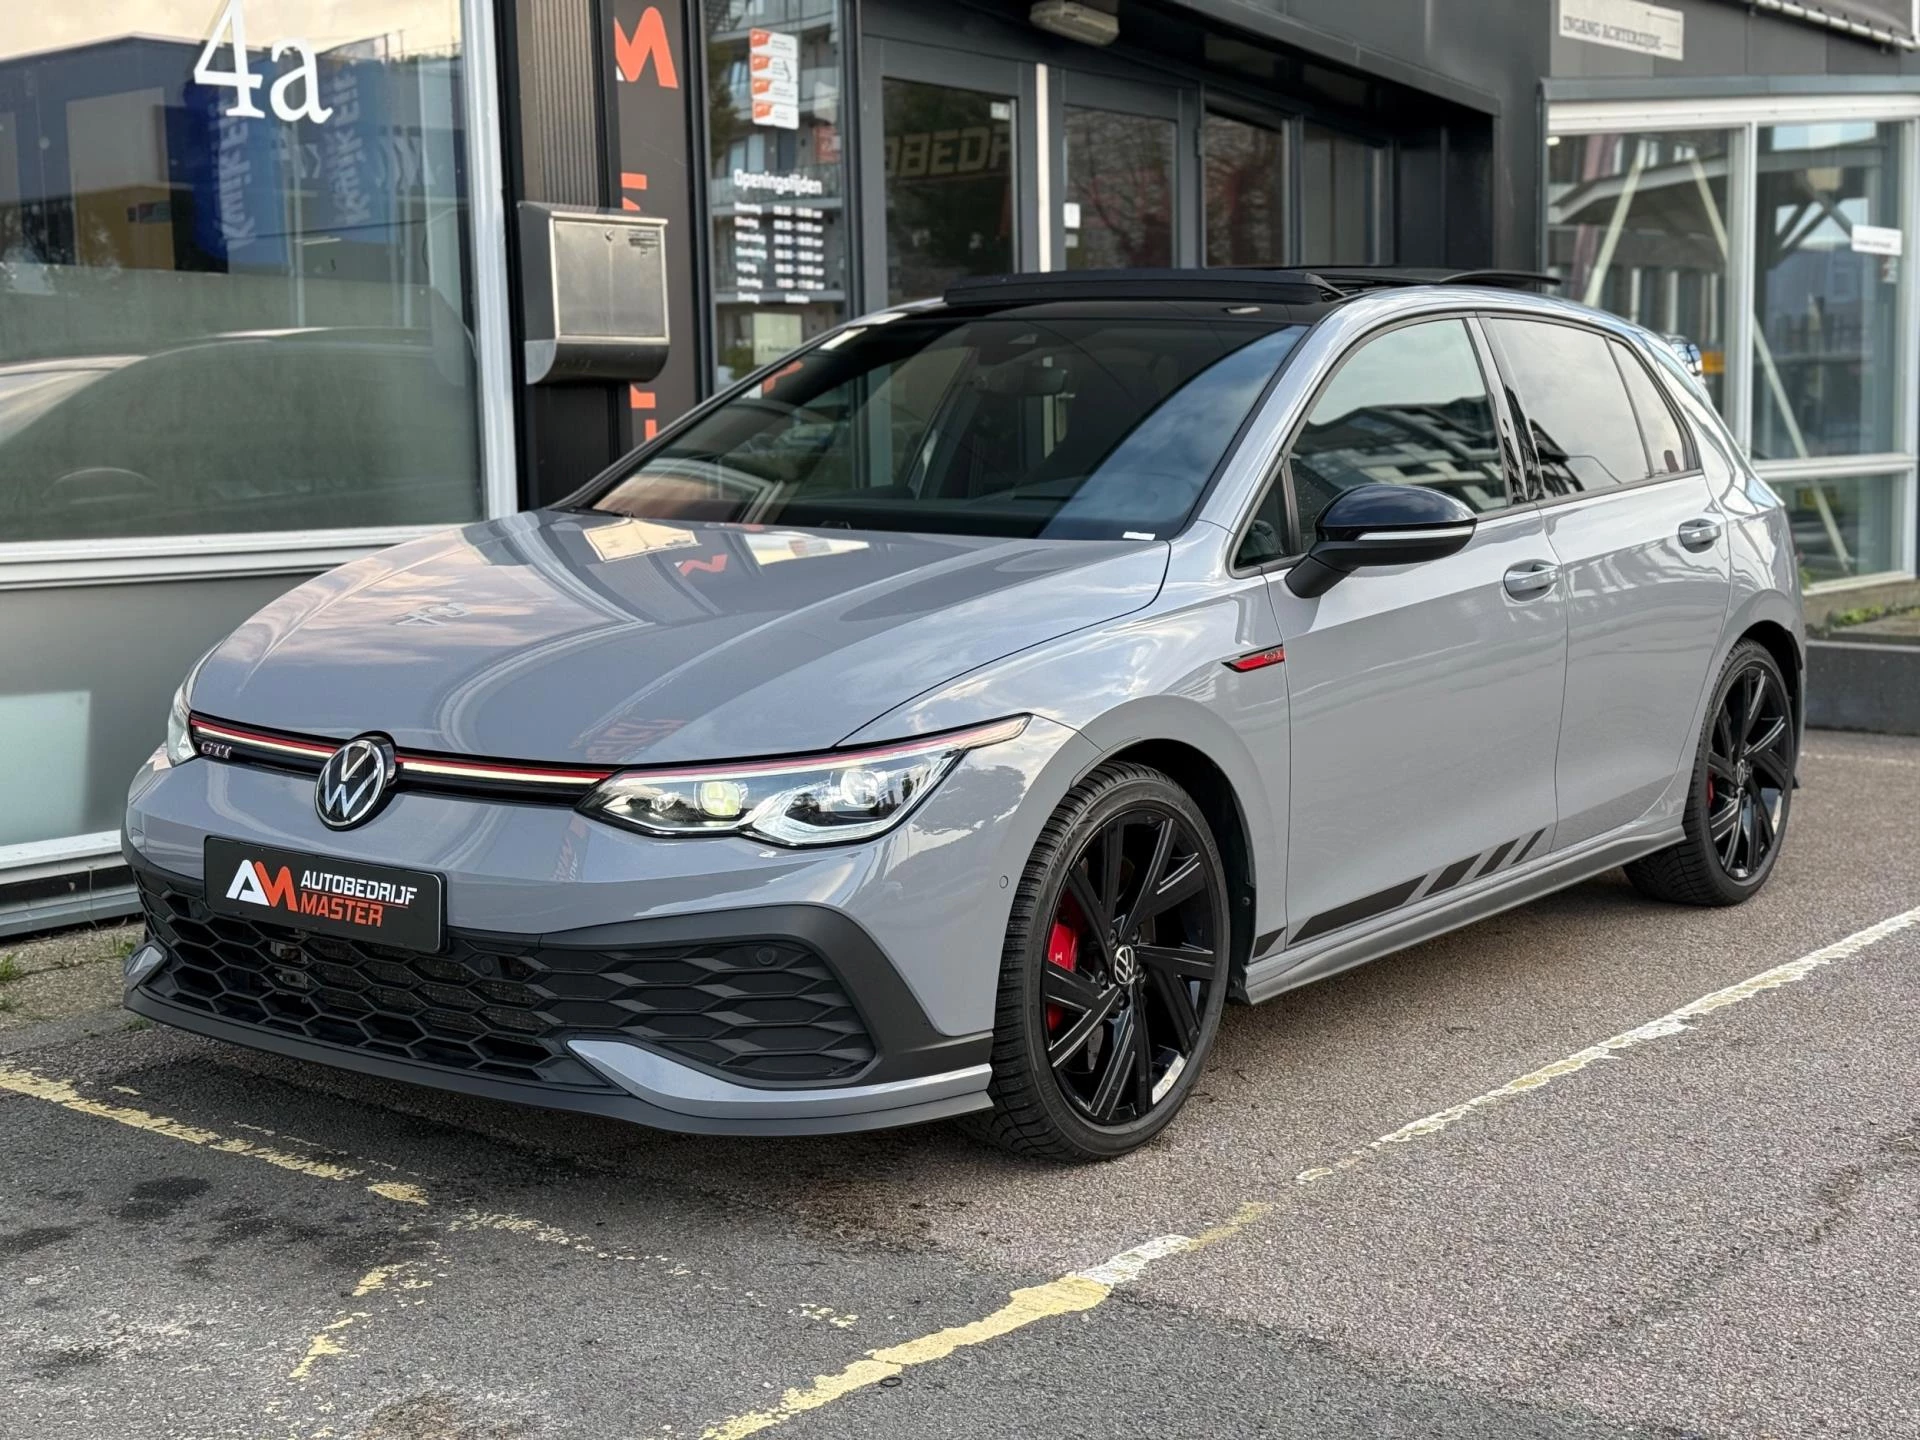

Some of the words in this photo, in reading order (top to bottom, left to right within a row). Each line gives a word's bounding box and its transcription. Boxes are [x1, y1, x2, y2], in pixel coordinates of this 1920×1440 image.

[193, 0, 334, 124] 4a
[613, 6, 679, 89] M
[734, 169, 822, 196] Openingstijden
[201, 741, 231, 760] GTI
[225, 859, 298, 912] AM
[300, 869, 418, 906] AUTOBEDRIJF
[300, 891, 384, 928] MASTER
